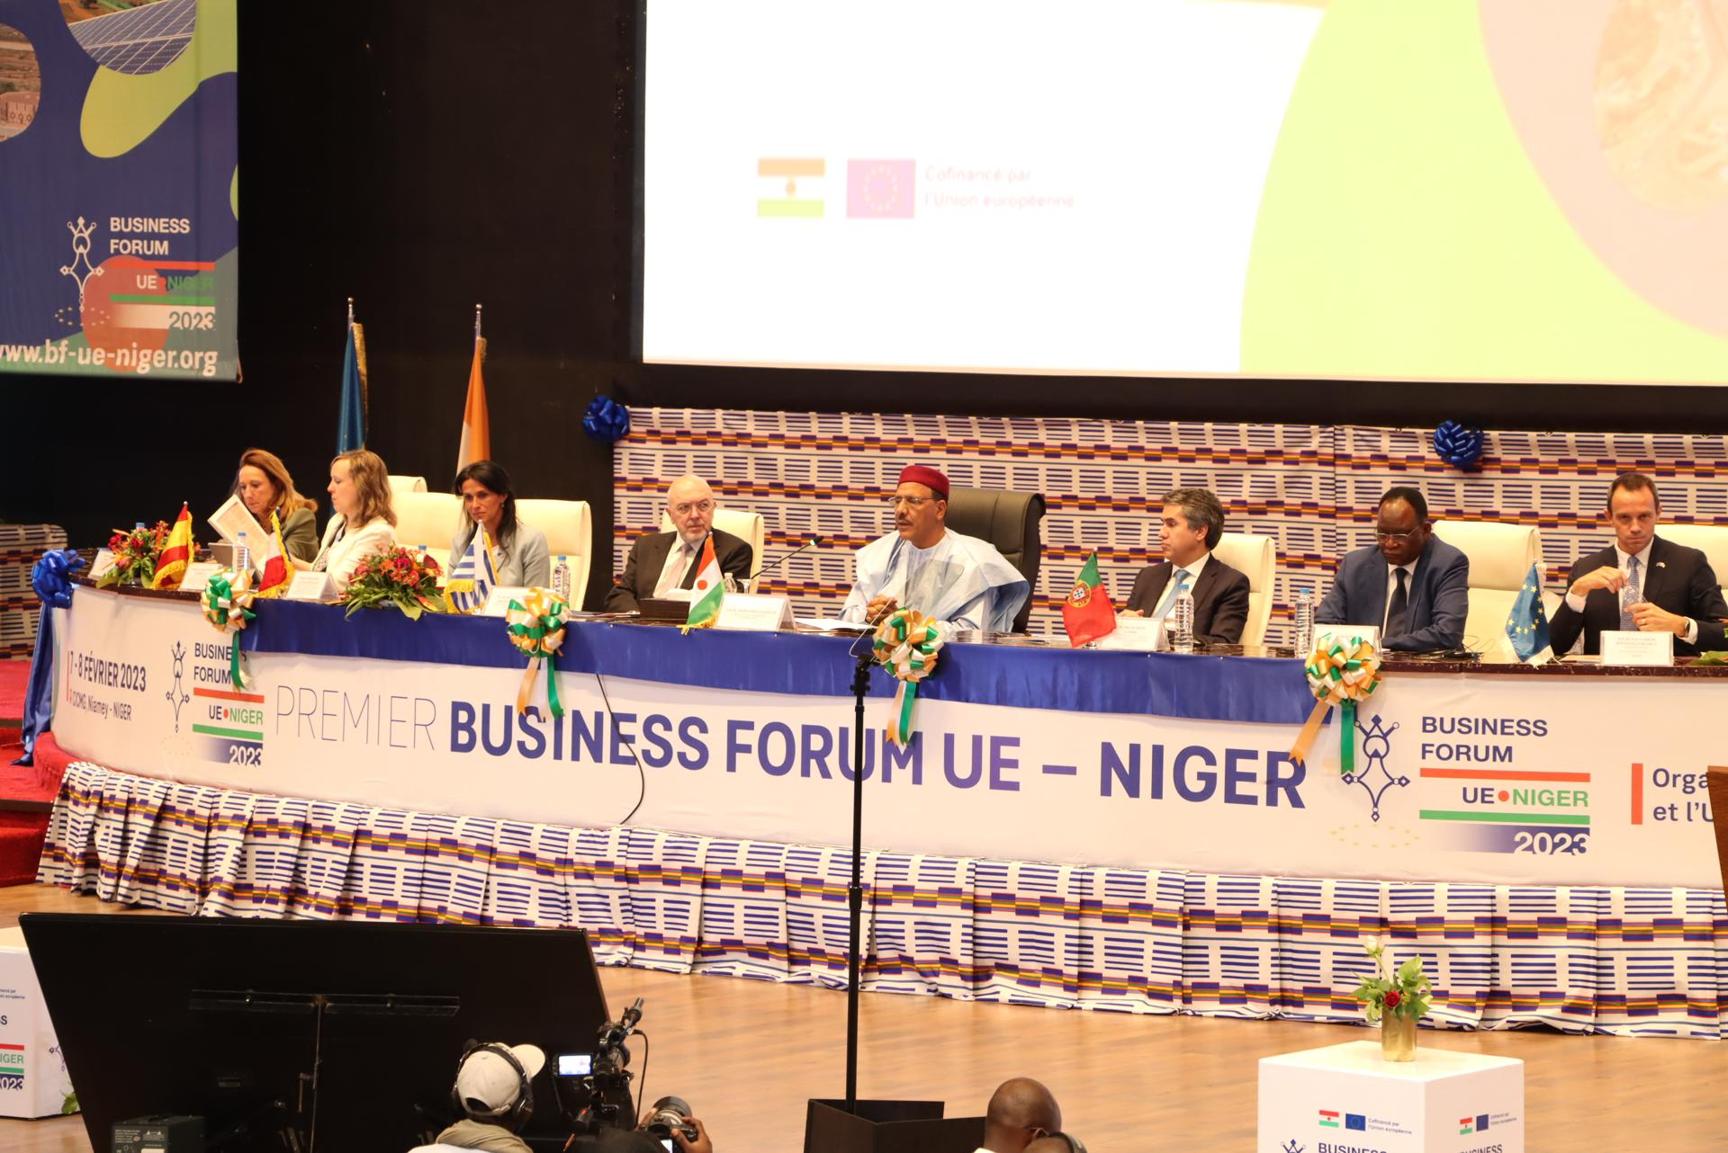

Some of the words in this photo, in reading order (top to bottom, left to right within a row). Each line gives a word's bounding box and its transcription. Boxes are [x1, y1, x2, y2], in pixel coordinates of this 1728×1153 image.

[110, 217, 190, 234] BUSINESS
[110, 239, 169, 255] FORUM
[136, 274, 158, 290] UE
[168, 311, 215, 331] 2023
[194, 642, 247, 662] BUSINE
[78, 653, 83, 678] 8
[84, 650, 119, 688] FÉVRIER
[120, 662, 146, 693] 2023
[193, 665, 232, 684] FORUM
[209, 705, 222, 720] UE
[230, 708, 264, 726] NIGER
[1421, 716, 1549, 737] BUSINESS
[229, 745, 263, 768] 2023
[276, 685, 436, 751] PREMIER
[451, 700, 709, 771] BUSINESS
[726, 719, 923, 785] FORUM
[943, 733, 1021, 792] UE
[1100, 741, 1307, 809] NIGER
[1421, 743, 1513, 762] FORUM
[1462, 787, 1495, 804] UE
[1513, 789, 1589, 808] NIGER
[1653, 803, 1678, 821] et
[1513, 831, 1589, 855] 2023
[0, 1053, 24, 1065] IGER
[0, 1076, 24, 1091] 023
